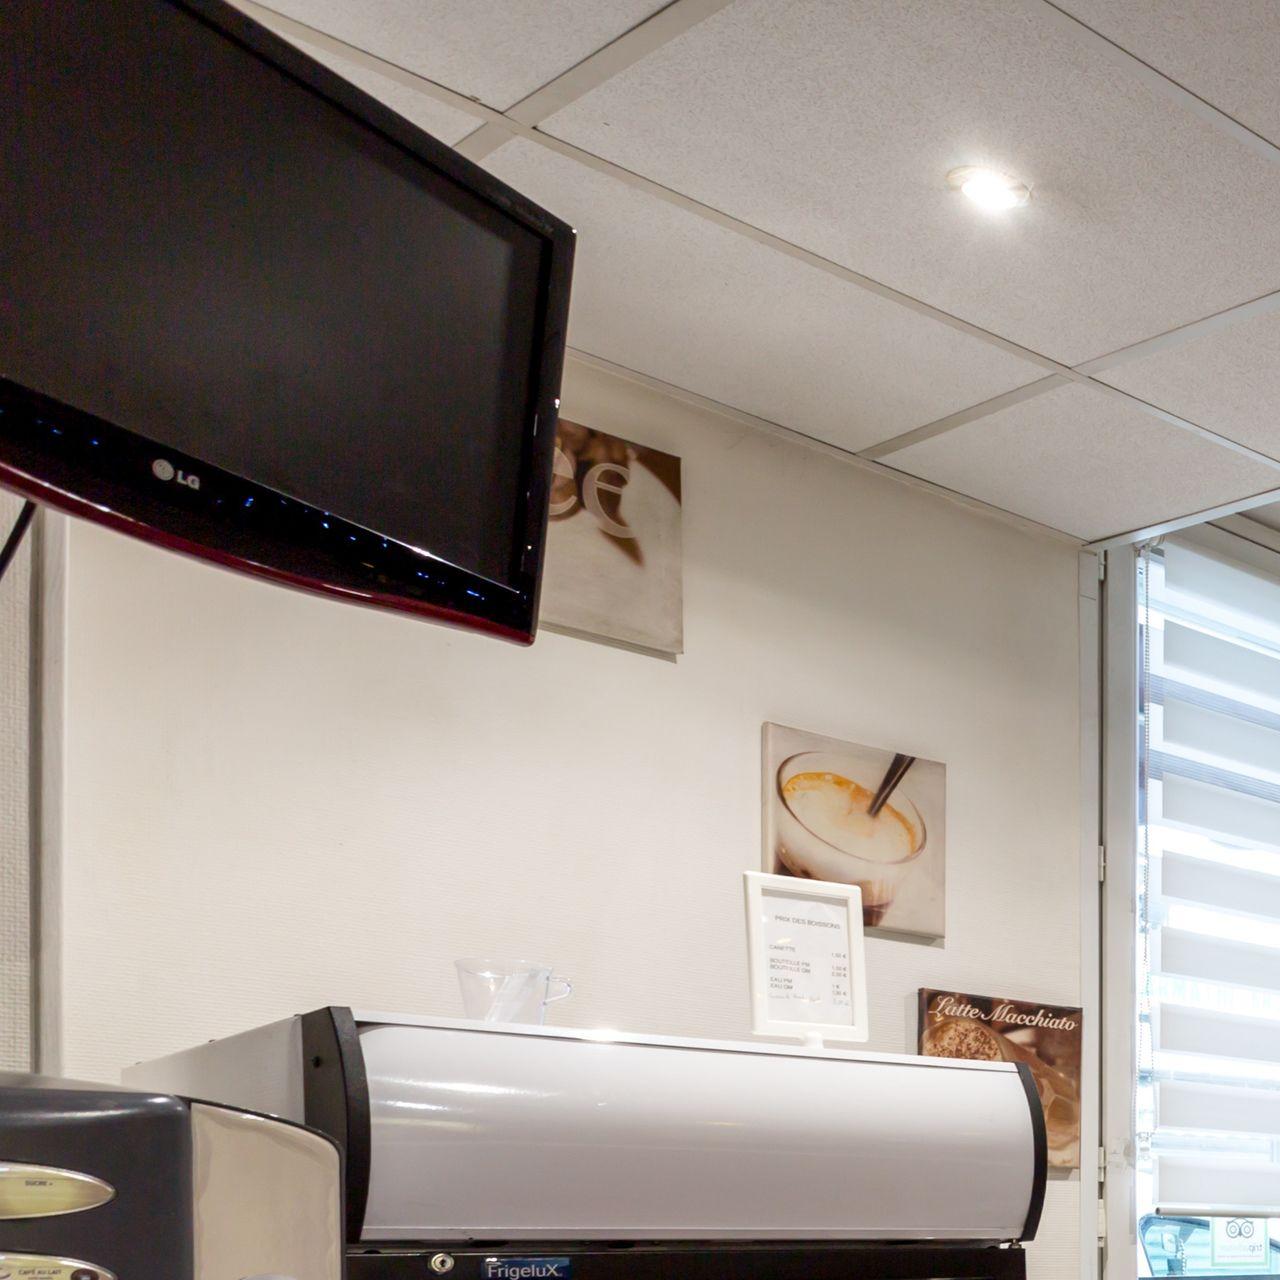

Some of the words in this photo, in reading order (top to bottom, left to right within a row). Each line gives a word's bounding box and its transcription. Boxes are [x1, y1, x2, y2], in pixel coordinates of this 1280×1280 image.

[177, 470, 200, 490] LG
[929, 996, 981, 1022] Latte
[981, 1003, 1077, 1031] Macchiato
